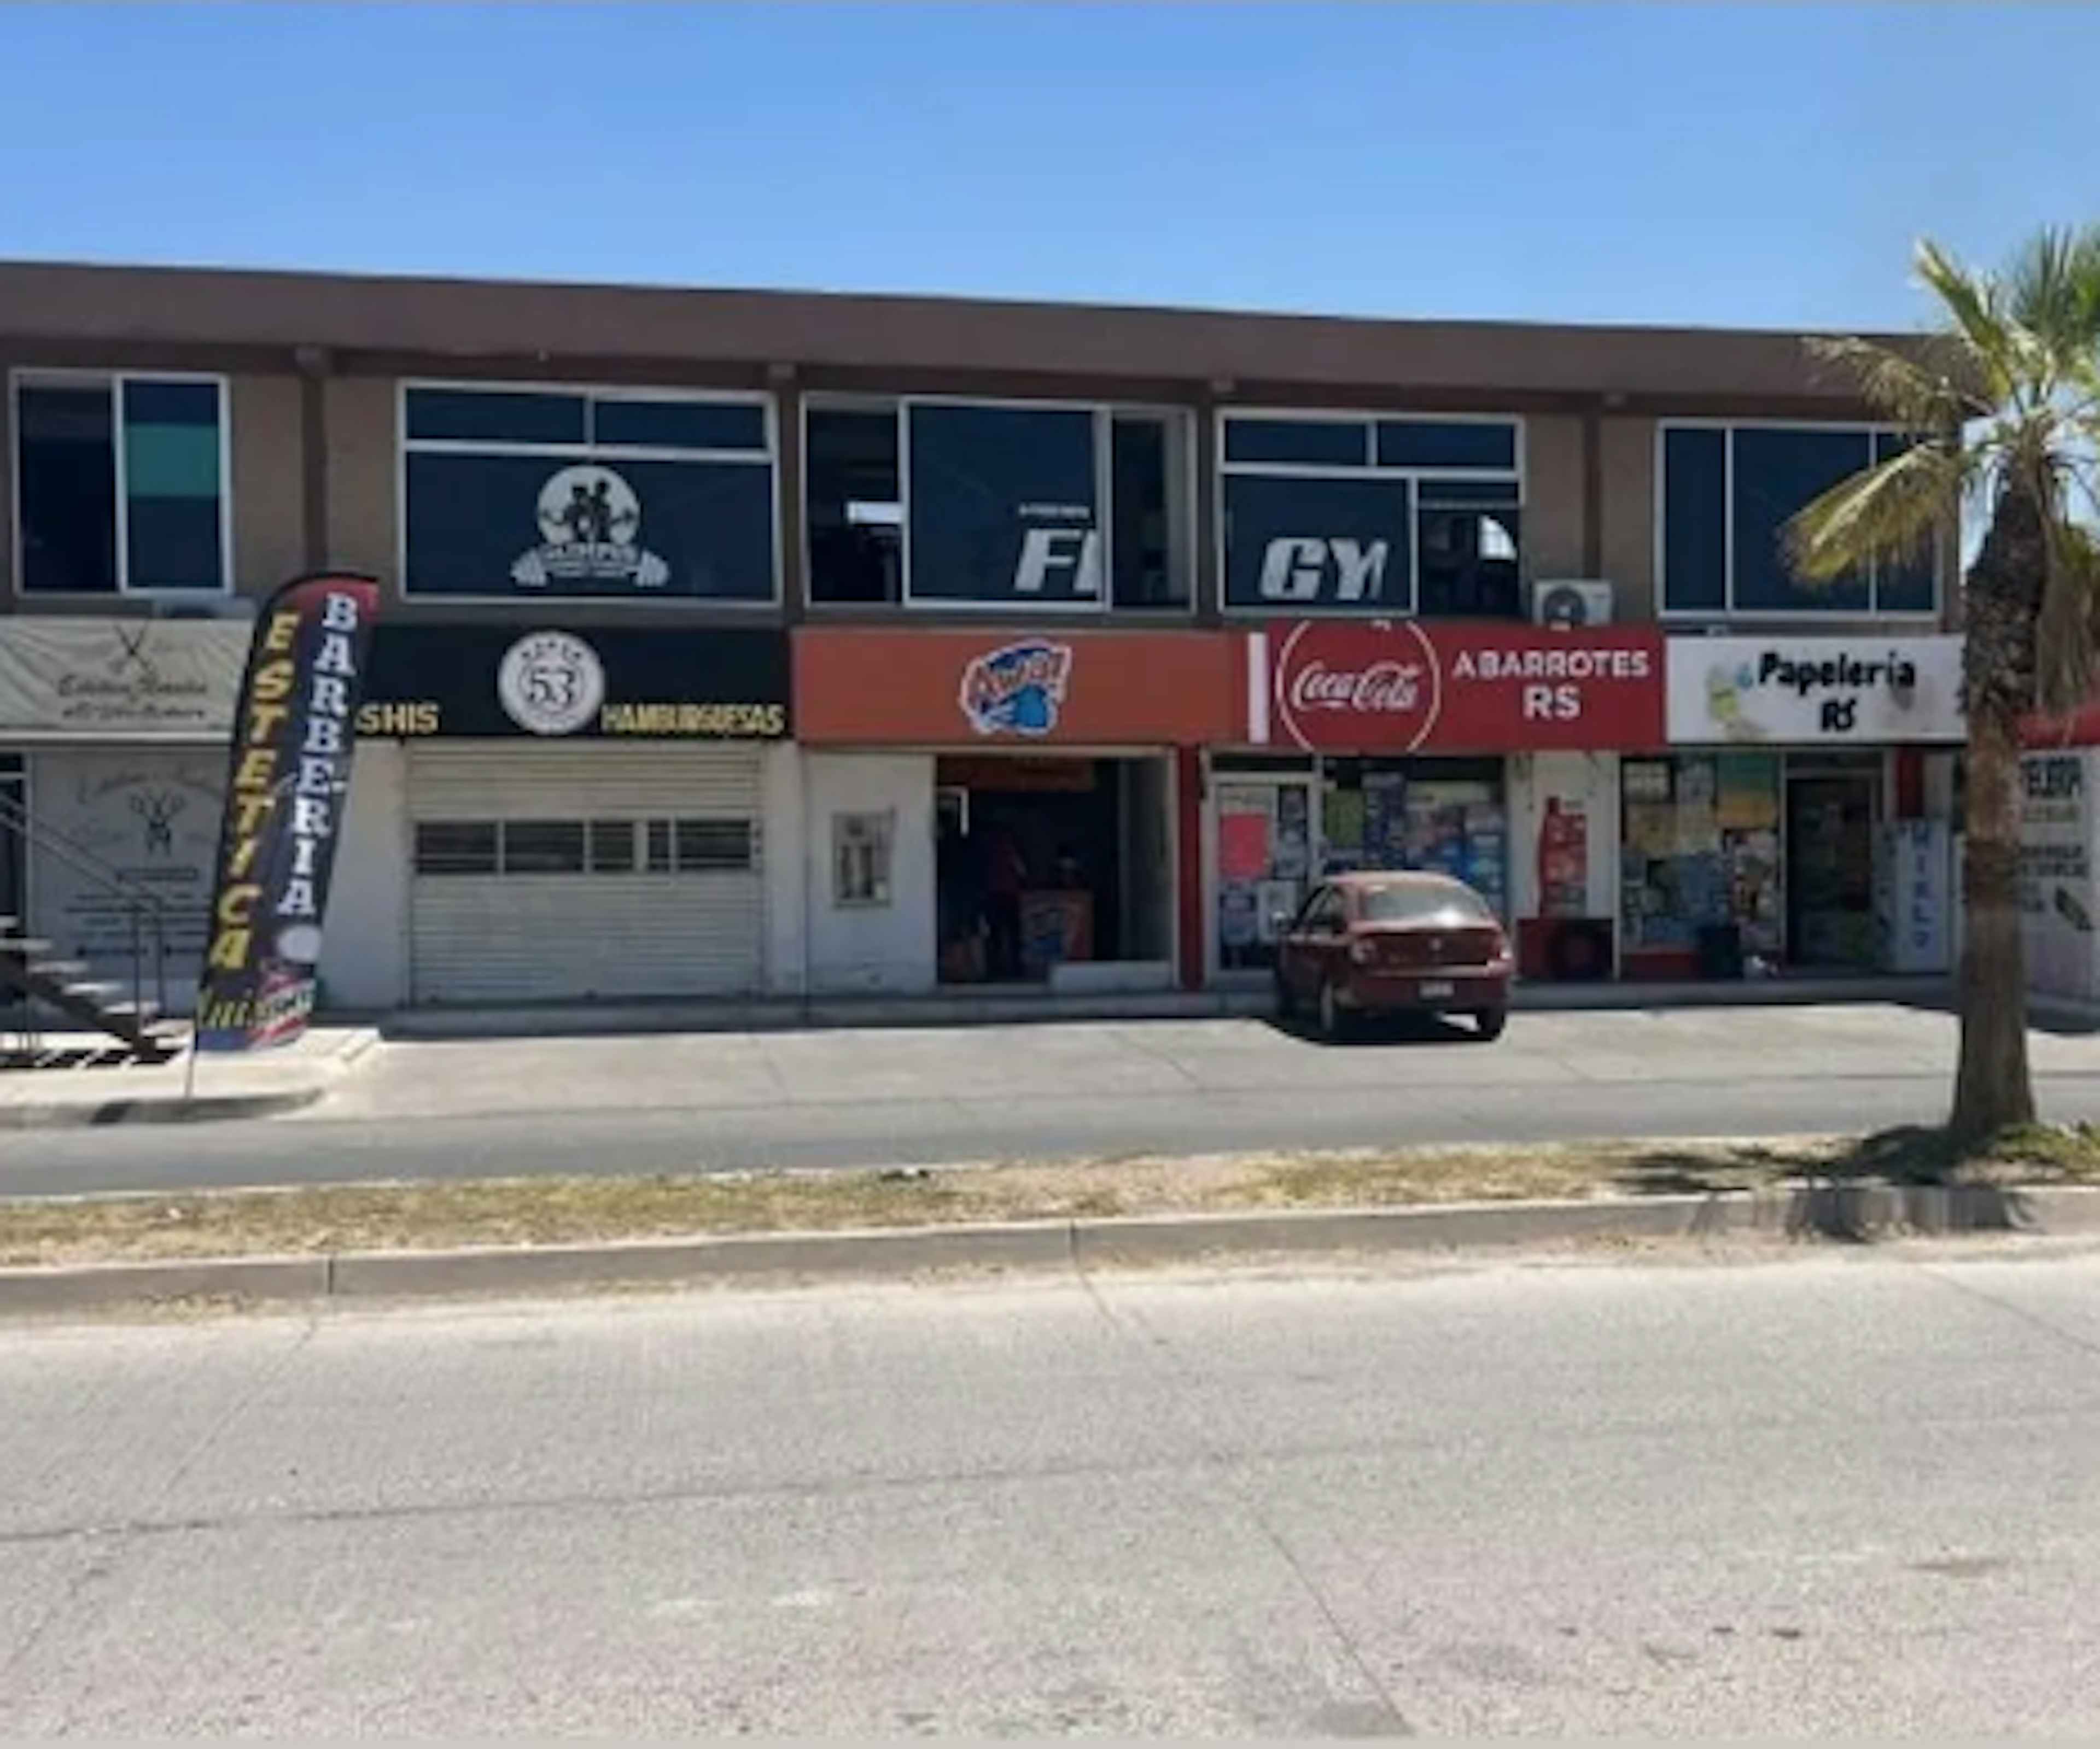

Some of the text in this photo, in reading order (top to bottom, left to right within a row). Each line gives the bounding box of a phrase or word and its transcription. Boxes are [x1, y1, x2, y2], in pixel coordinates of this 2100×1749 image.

[1452, 648, 1649, 678] ABARROTES
[528, 667, 575, 709] 53
[1522, 685, 1582, 720] RS
[355, 702, 440, 735] SHIS
[277, 592, 357, 916] BARBERIA
[210, 609, 301, 970] ESTETICA
